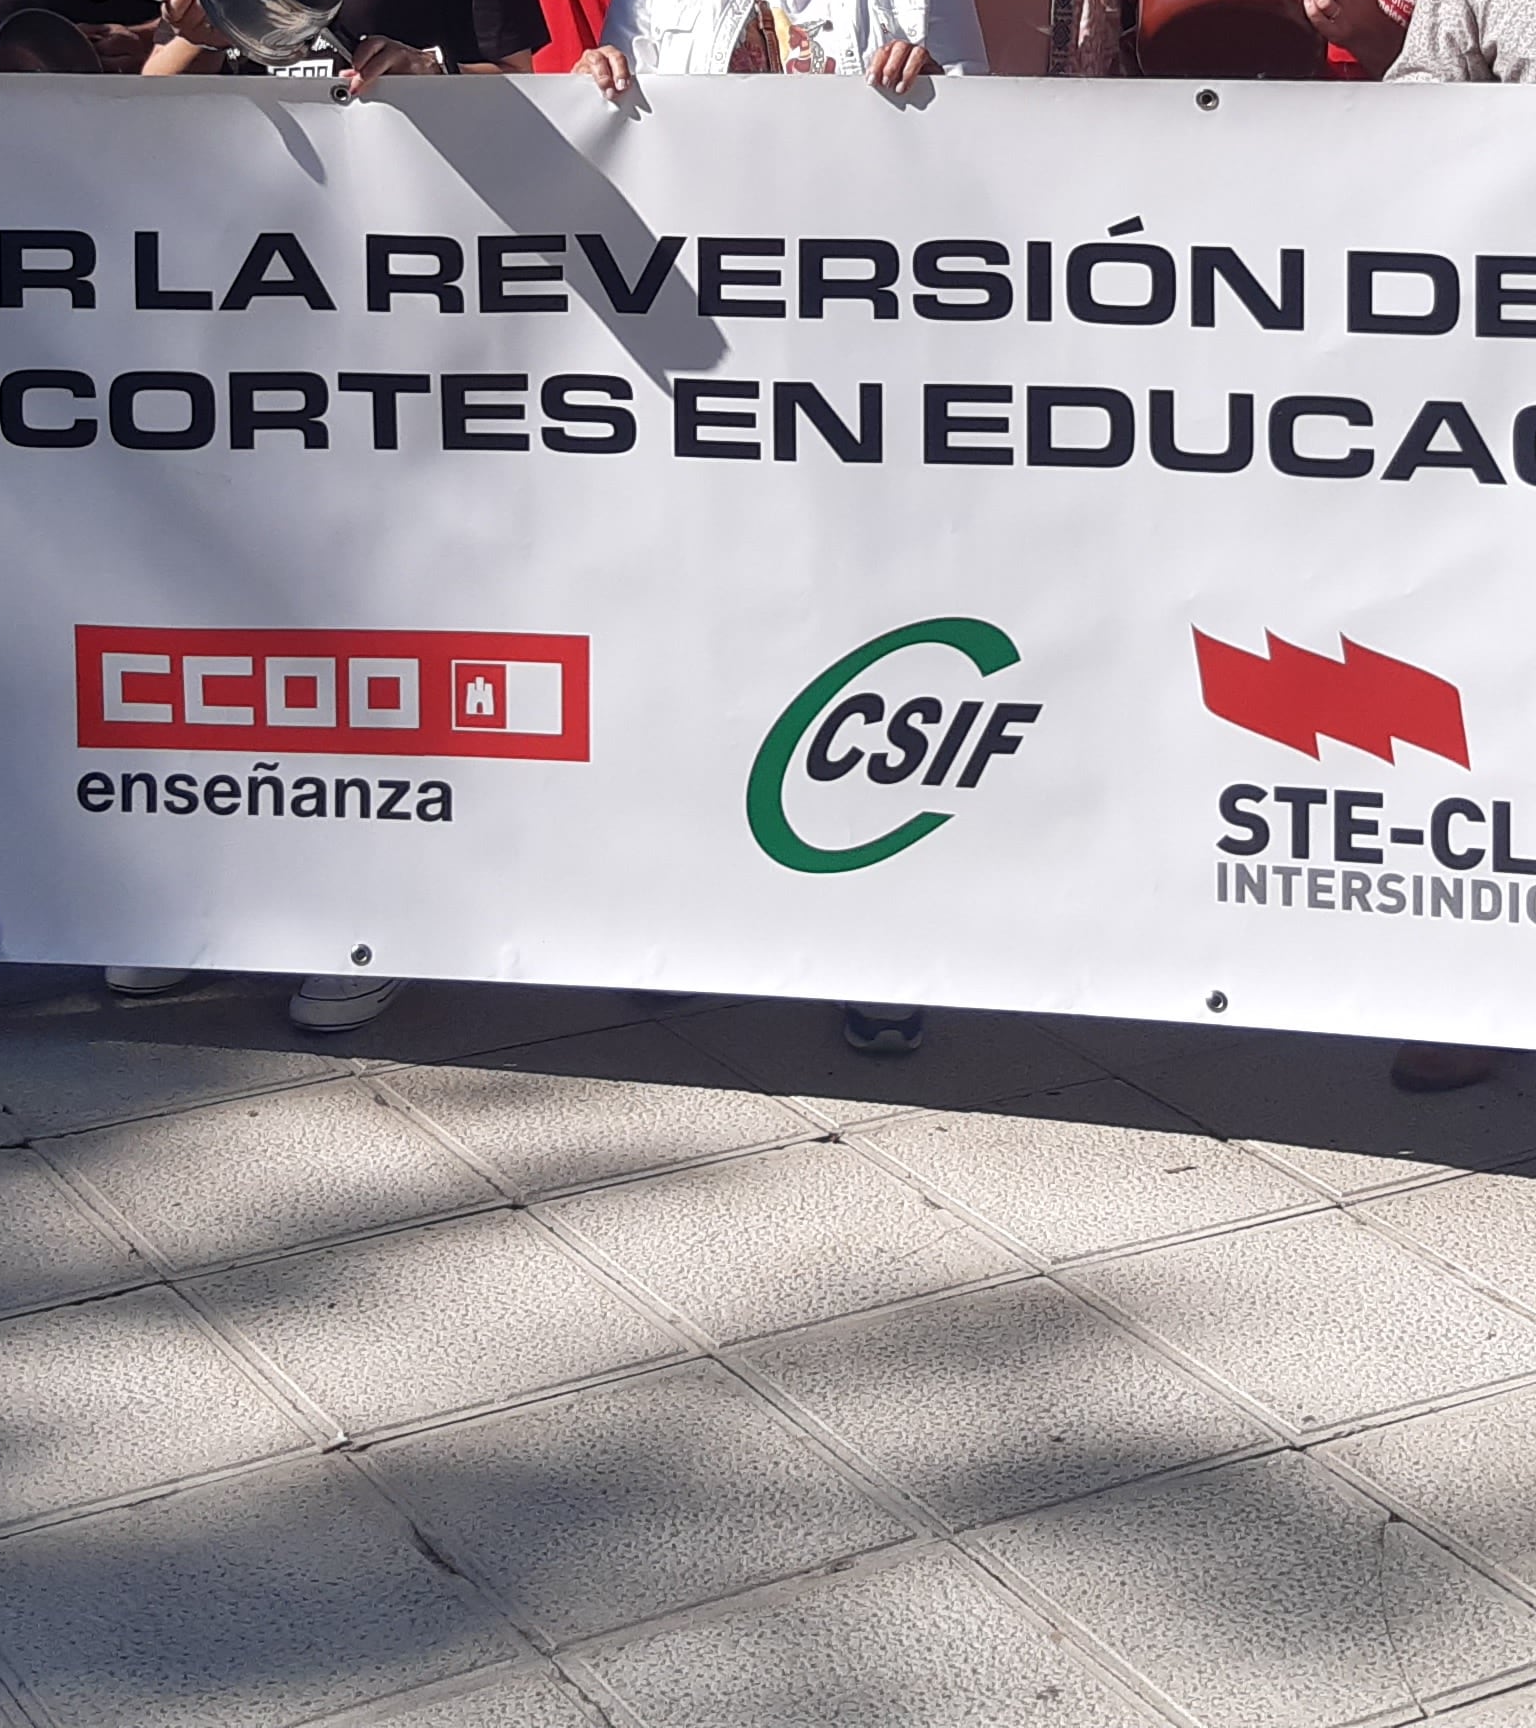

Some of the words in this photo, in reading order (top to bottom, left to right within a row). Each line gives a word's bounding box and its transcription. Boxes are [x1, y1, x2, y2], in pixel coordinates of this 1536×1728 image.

[134, 231, 337, 311] LA
[365, 215, 1305, 331] REVERSIÓN
[673, 377, 883, 464] EN
[101, 651, 420, 729] CCOO
[805, 693, 1044, 789] CSIF
[76, 761, 454, 823] enseñanza
